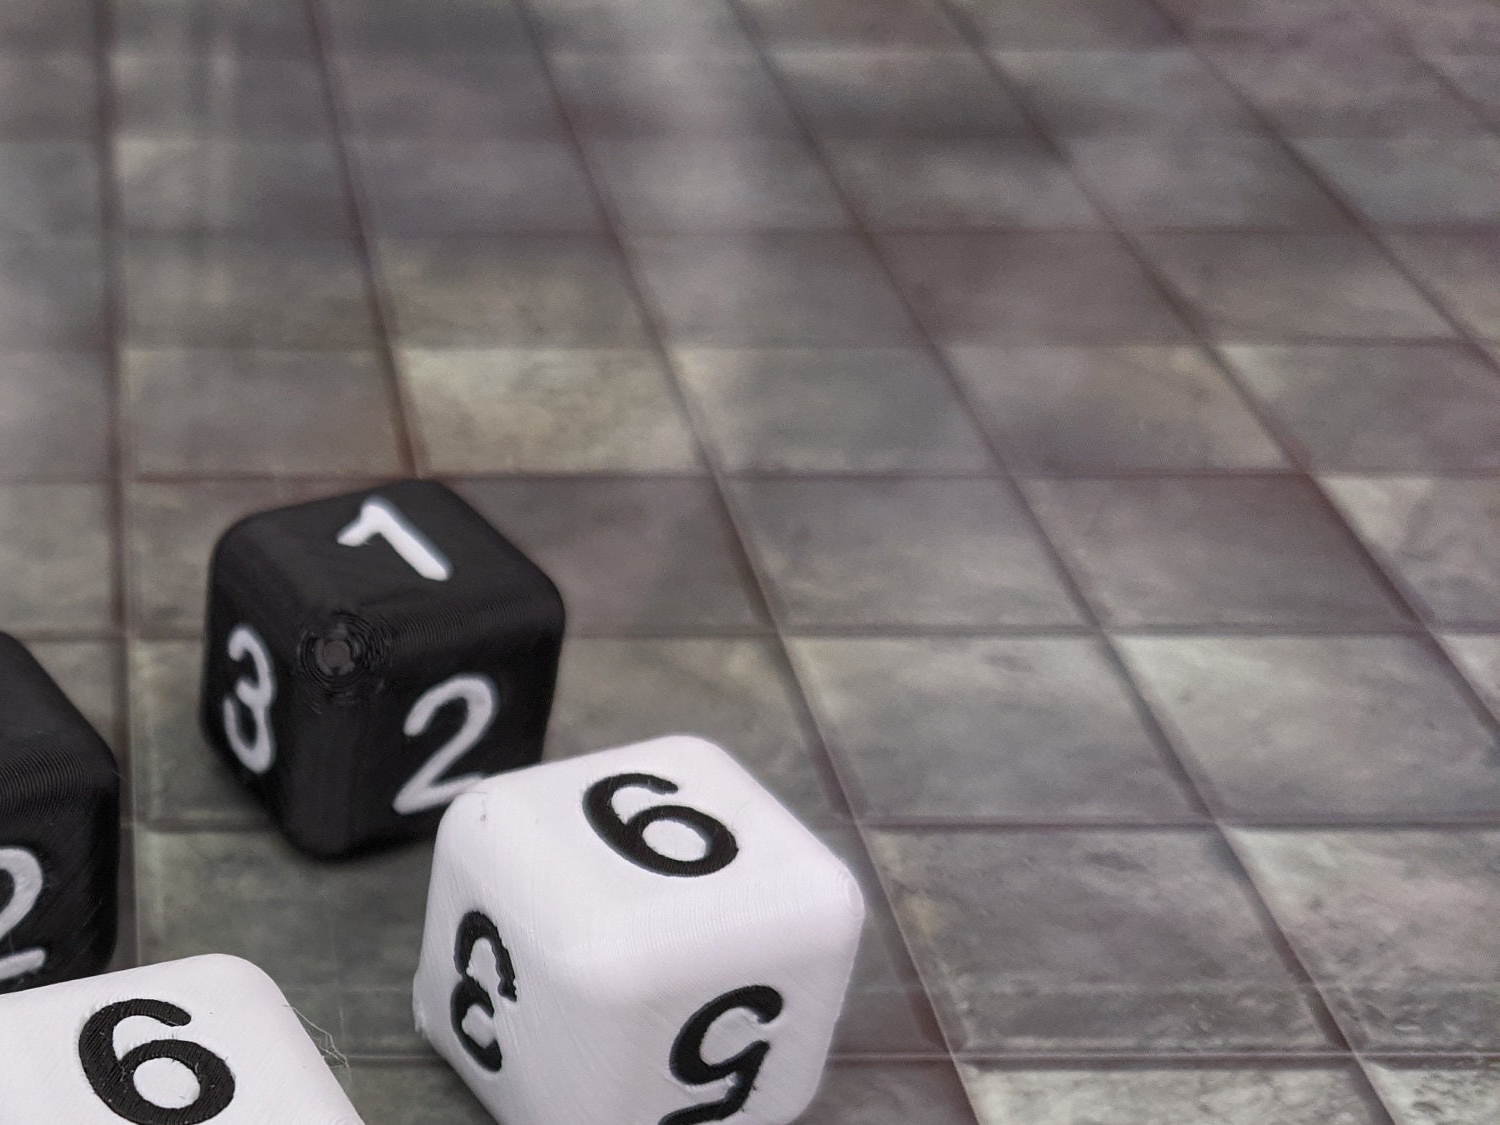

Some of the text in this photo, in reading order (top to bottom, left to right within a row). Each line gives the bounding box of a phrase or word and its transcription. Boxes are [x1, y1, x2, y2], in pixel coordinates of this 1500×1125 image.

[337, 499, 449, 582] 1
[223, 625, 275, 773] 3
[393, 674, 496, 813] 2
[581, 772, 740, 878] 6
